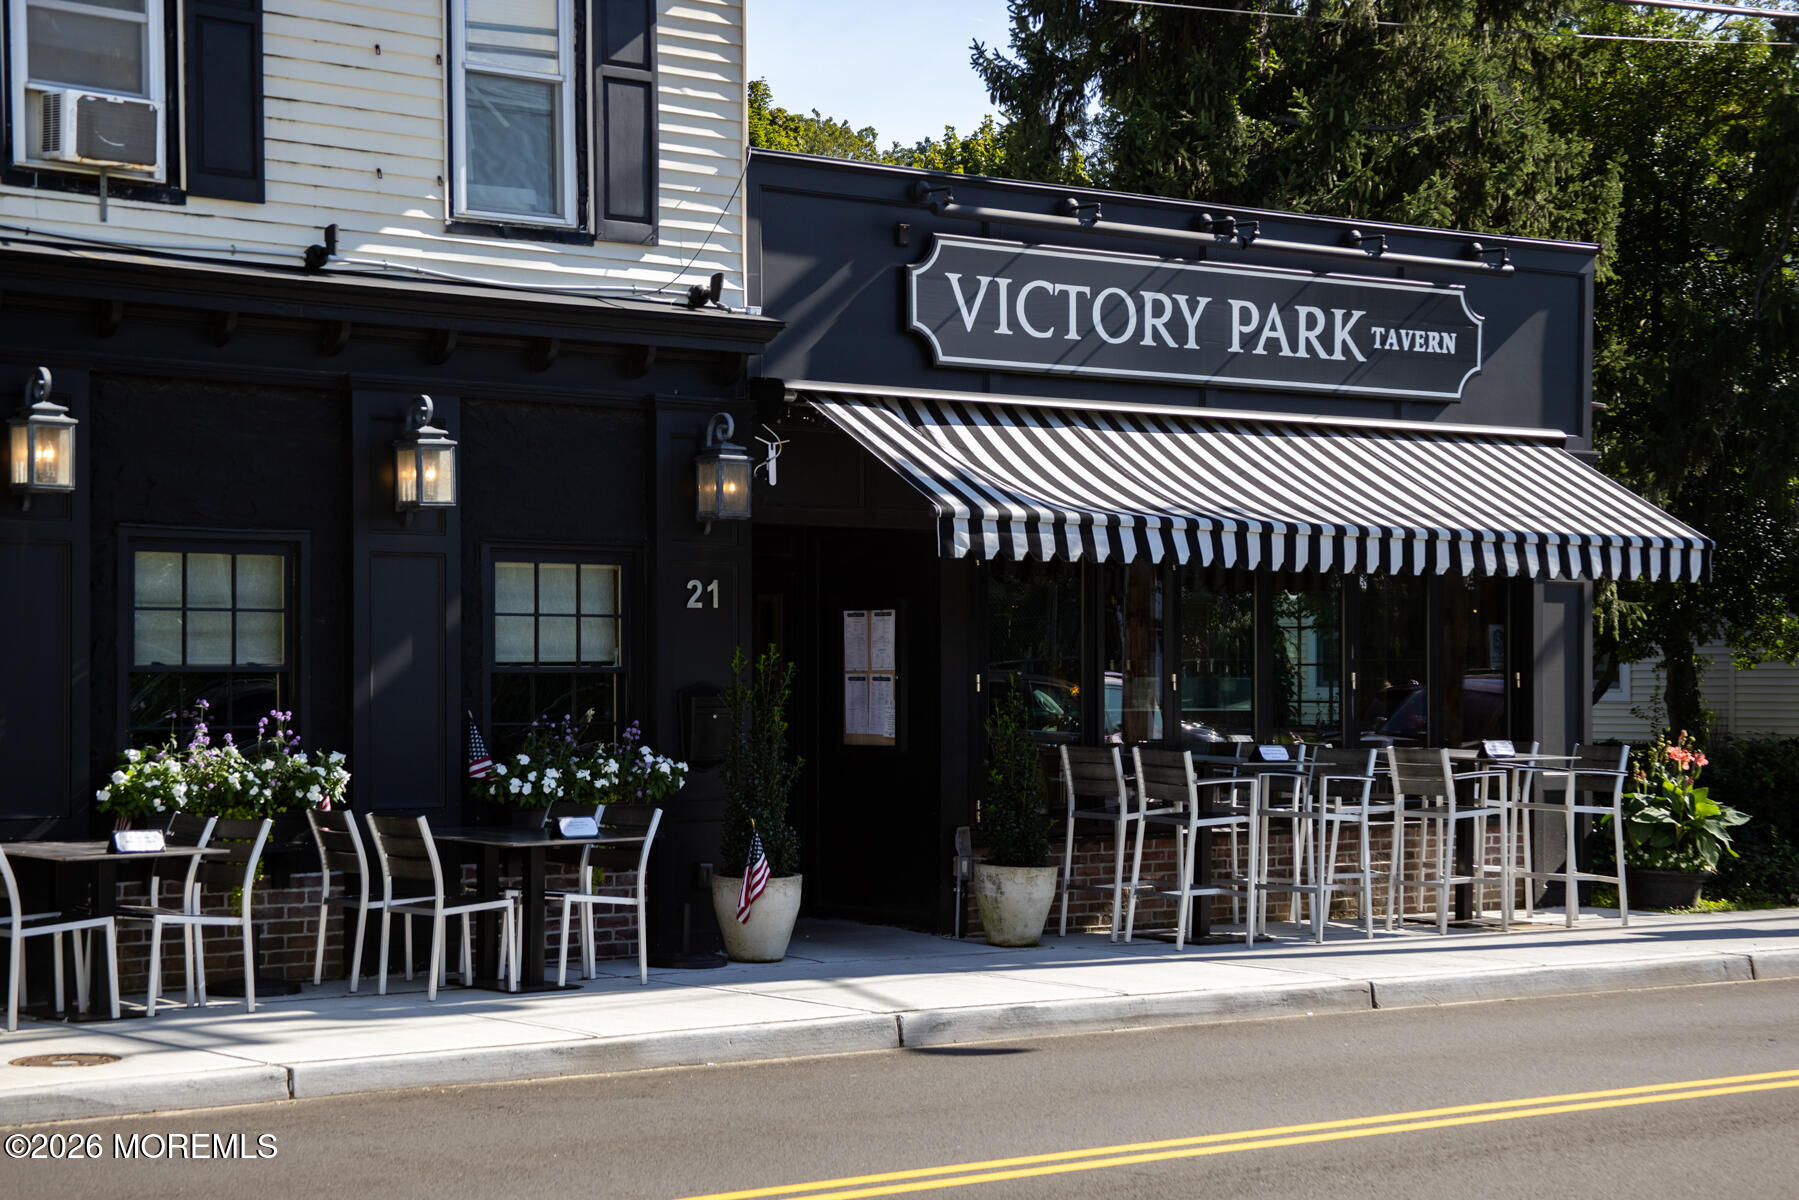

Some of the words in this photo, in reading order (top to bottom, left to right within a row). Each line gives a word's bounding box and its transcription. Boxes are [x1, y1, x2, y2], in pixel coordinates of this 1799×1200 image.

[944, 272, 1213, 350] VICTORY
[1227, 298, 1368, 362] PARK
[1370, 326, 1457, 355] TAVERN
[686, 579, 719, 609] 21
